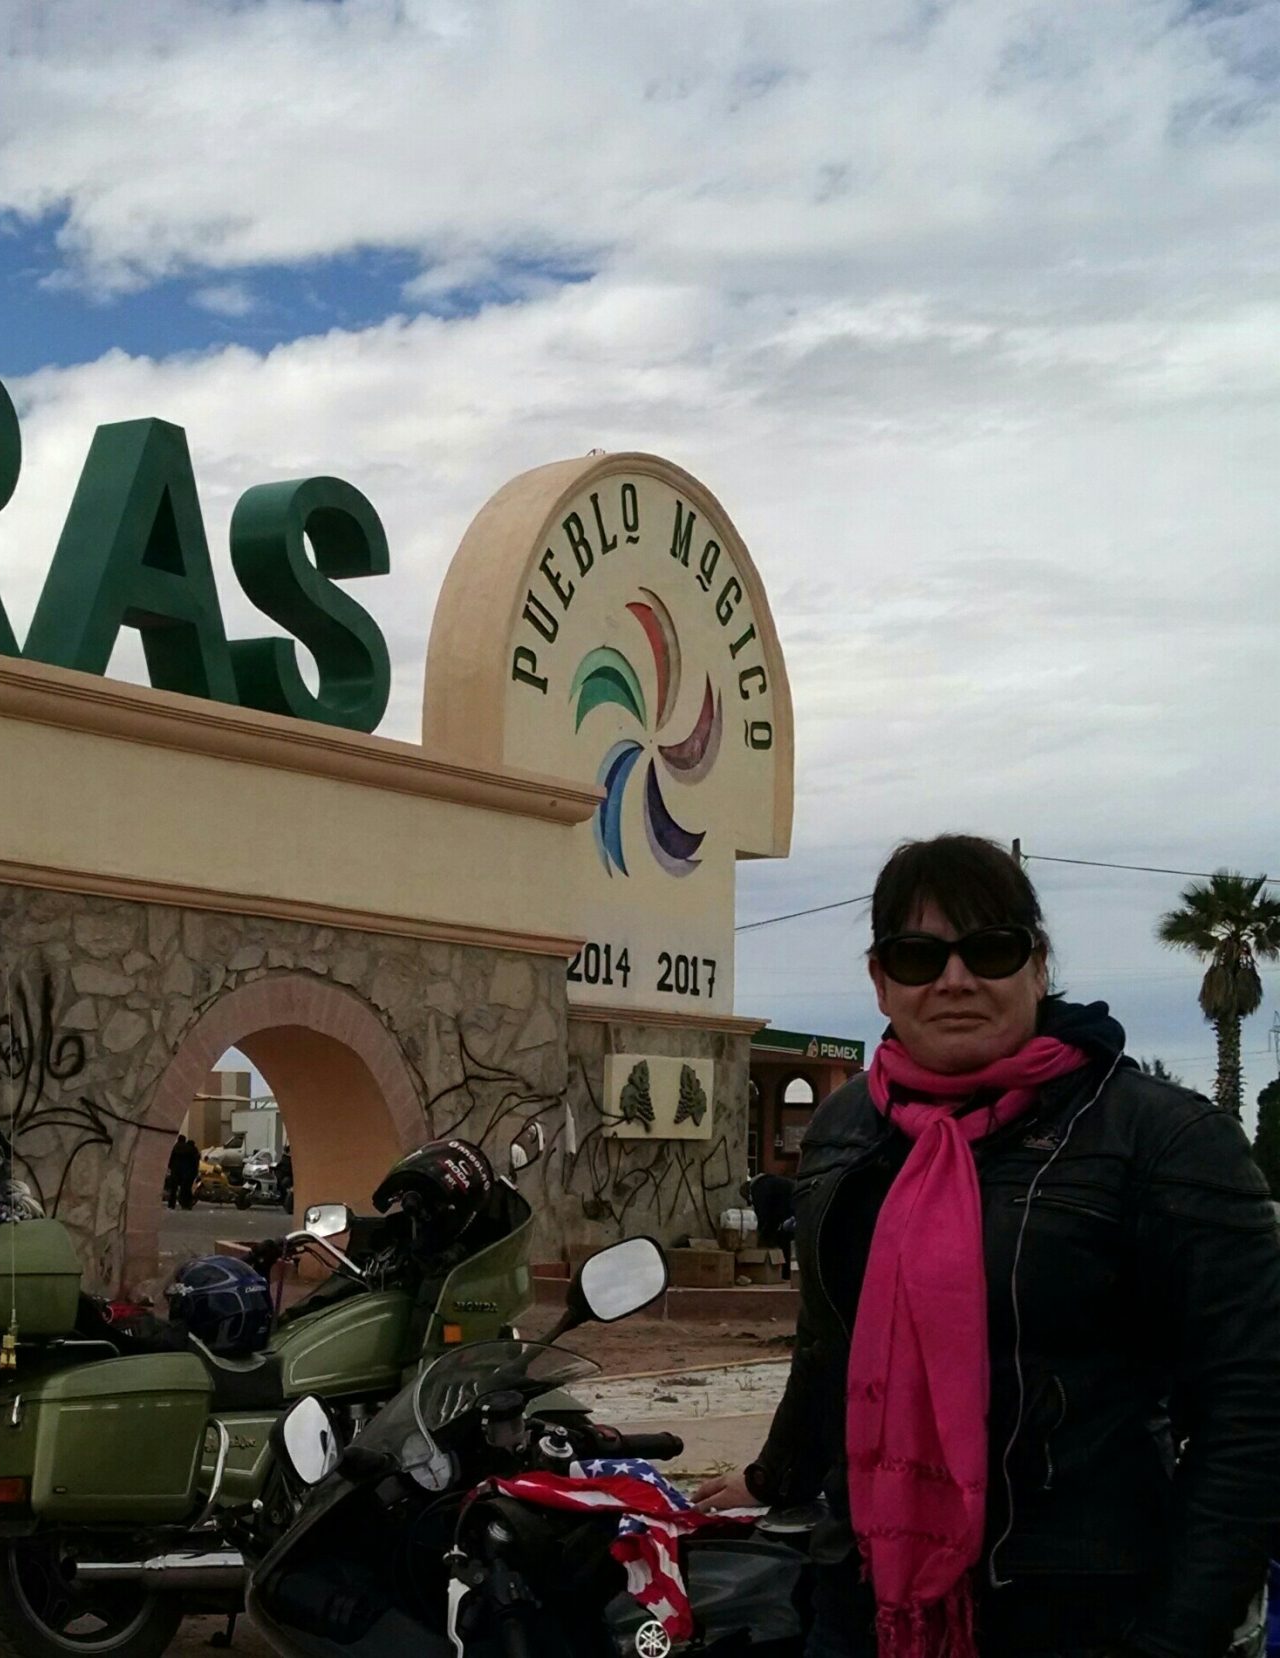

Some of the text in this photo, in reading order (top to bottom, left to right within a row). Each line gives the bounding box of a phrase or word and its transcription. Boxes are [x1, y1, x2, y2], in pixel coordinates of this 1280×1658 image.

[511, 482, 640, 695] PUEBLO
[567, 943, 716, 998] 2014 2017
[820, 1042, 858, 1060] PEMEX
